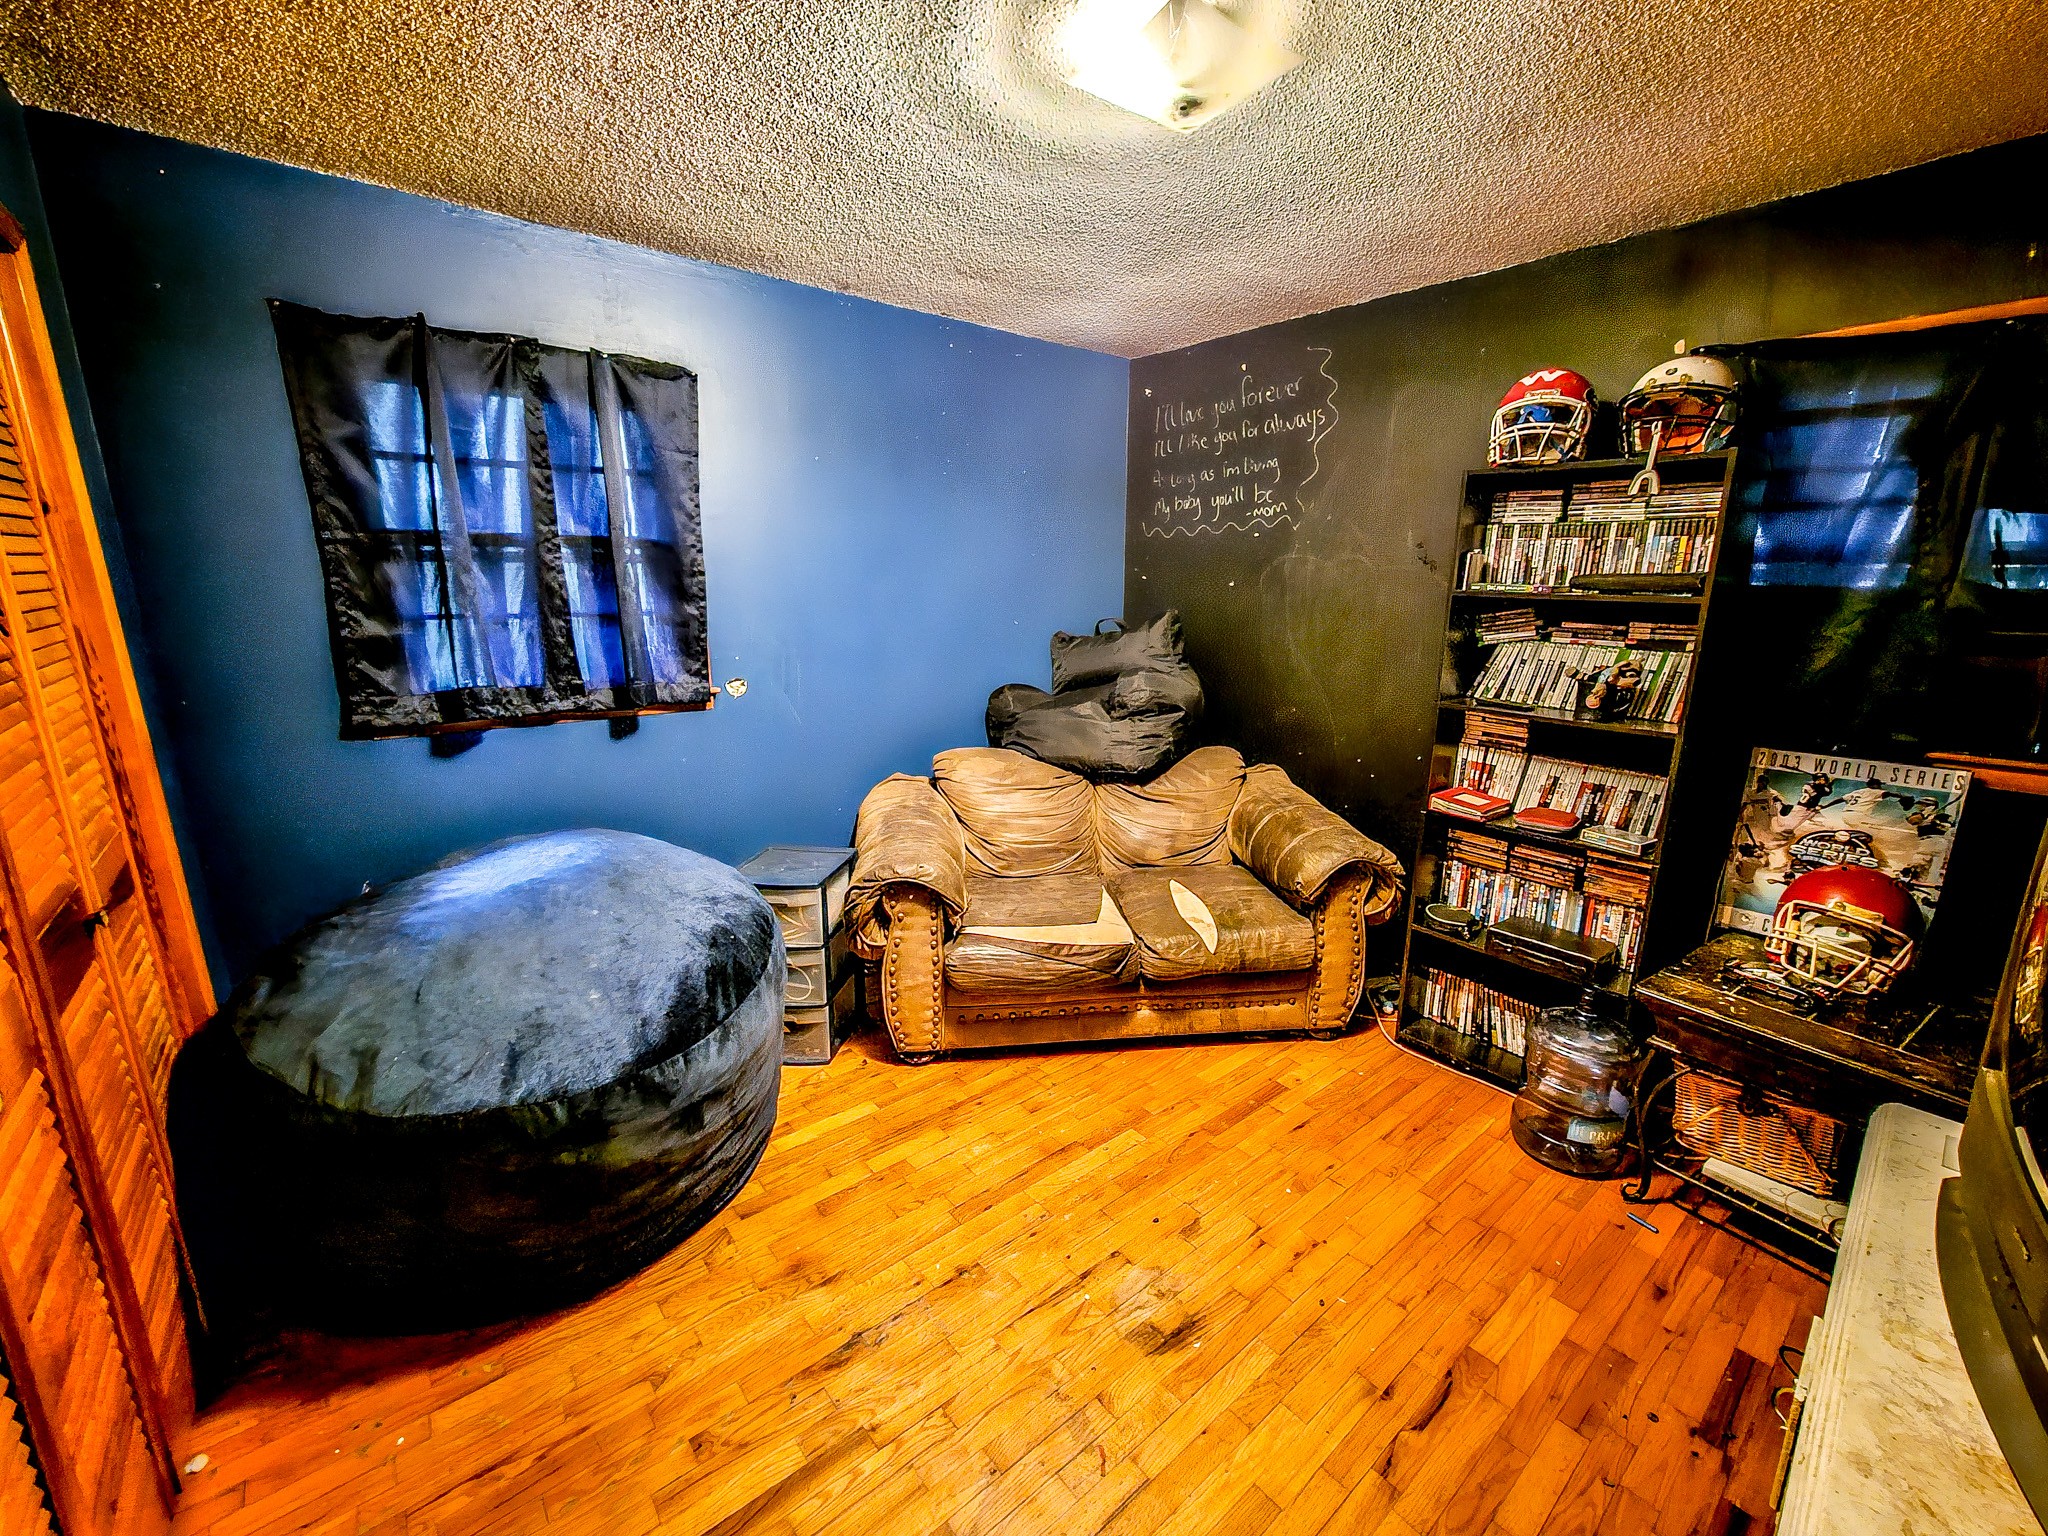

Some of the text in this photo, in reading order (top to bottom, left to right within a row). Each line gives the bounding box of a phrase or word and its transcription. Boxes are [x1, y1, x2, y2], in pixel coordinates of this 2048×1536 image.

[1211, 399, 1237, 430] you
[1241, 374, 1303, 408] forever
[1178, 432, 1209, 455] like
[1213, 430, 1239, 456] you
[1242, 419, 1260, 438] for
[1264, 408, 1326, 442] always
[1152, 469, 1166, 489] A
[1169, 472, 1196, 494] log
[1200, 468, 1215, 482] as
[1244, 456, 1281, 484] living
[1174, 495, 1202, 521] baby
[1211, 486, 1244, 522] you'll
[1254, 482, 1274, 504] be
[1757, 751, 1966, 791] 2003 WORLD SERIES
[1788, 844, 1879, 868] SERIES
[1799, 838, 1871, 857] WORLD
